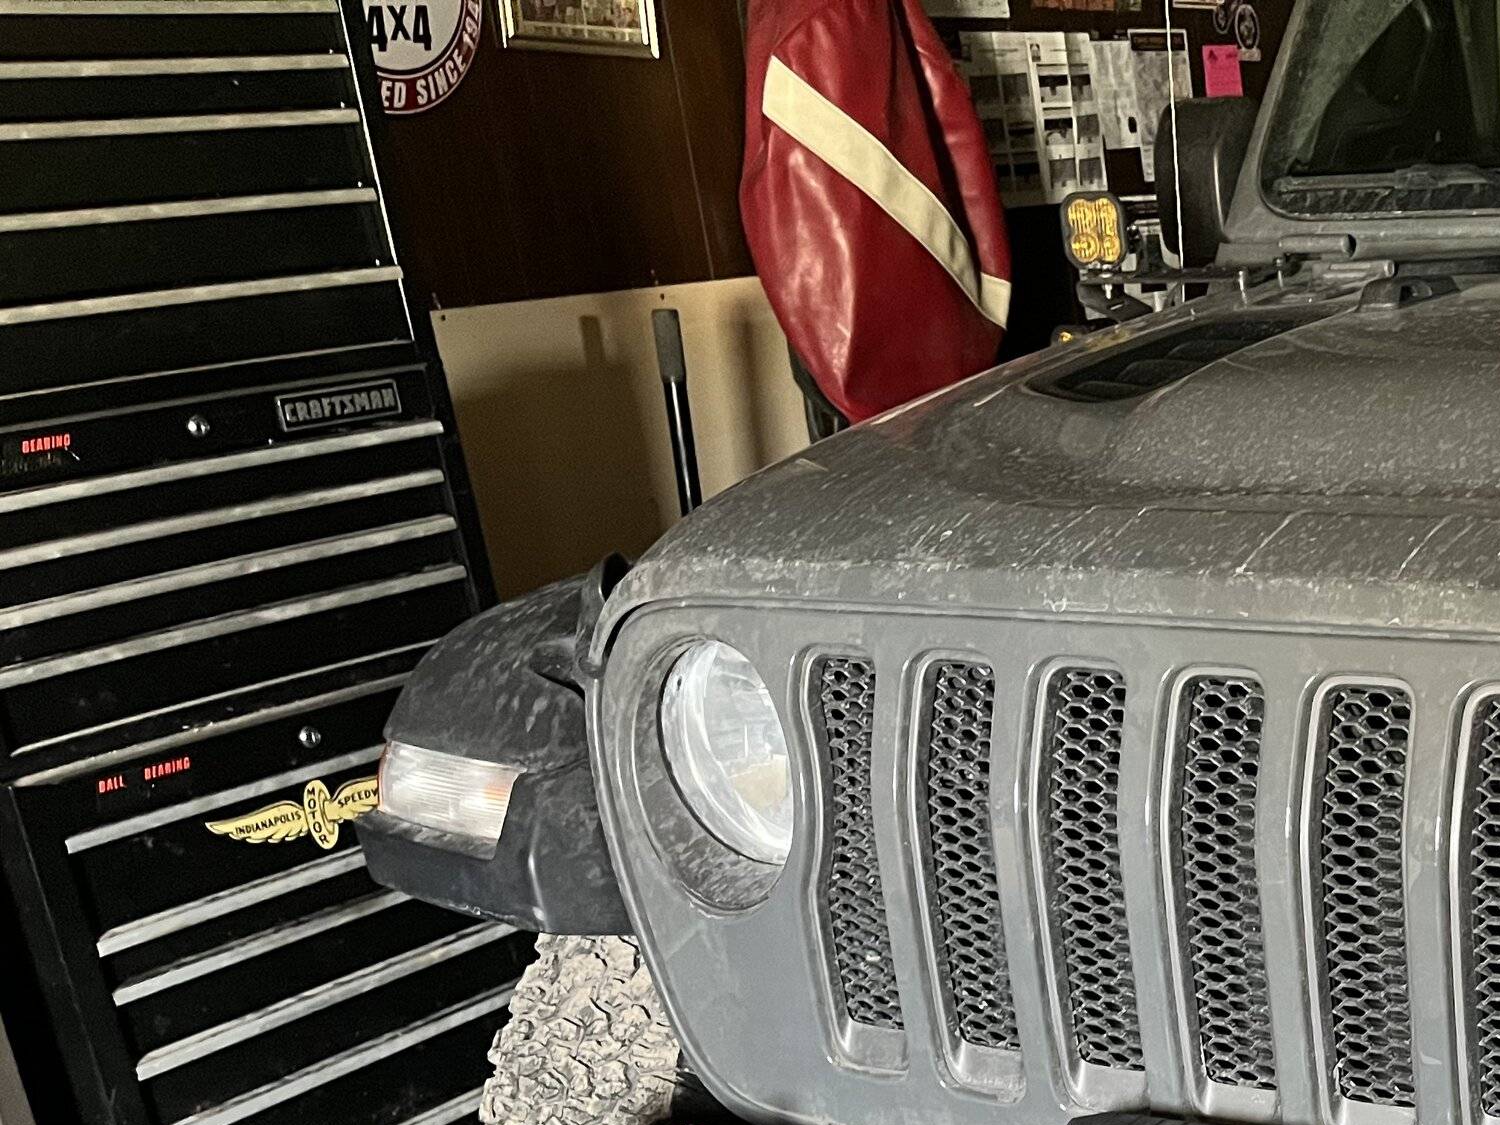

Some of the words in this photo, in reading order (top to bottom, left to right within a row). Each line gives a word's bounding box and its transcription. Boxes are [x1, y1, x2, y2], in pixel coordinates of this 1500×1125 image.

[367, 4, 432, 52] 4X4
[415, 48, 467, 105] SINCE
[284, 388, 395, 423] CRAFTSMAN
[144, 756, 191, 781] BEARING
[234, 809, 302, 836] INDIANAPOLIS
[306, 786, 330, 845] MOTOR
